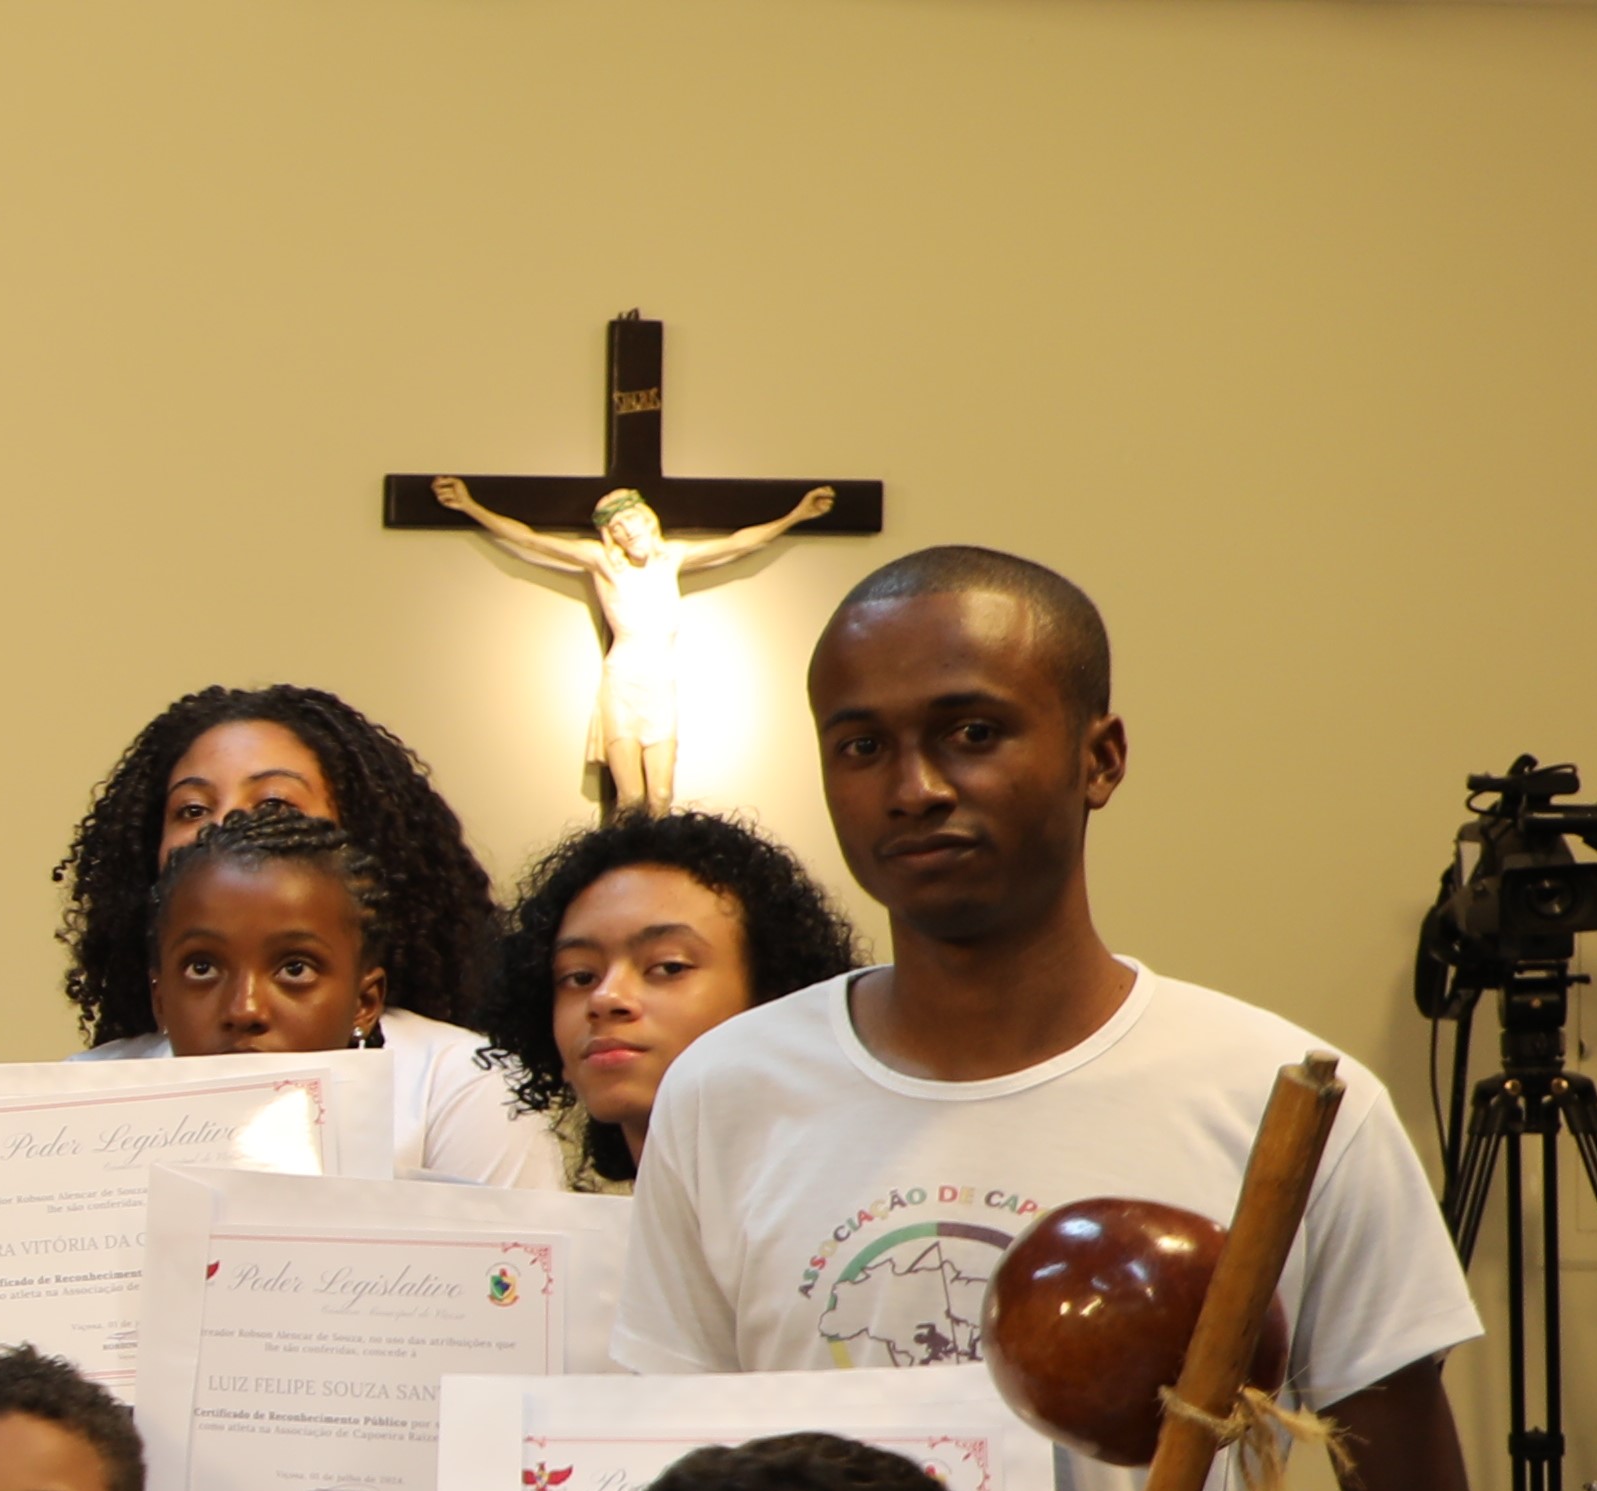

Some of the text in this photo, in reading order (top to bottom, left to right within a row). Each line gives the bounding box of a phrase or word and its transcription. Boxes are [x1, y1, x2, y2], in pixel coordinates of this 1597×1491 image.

[20, 1234, 131, 1257] VITÓRIA DA
[797, 1184, 976, 1299] ASSOCIAÇÃO DE
[208, 1375, 391, 1399] LUIZ FELIPE SOUZA
